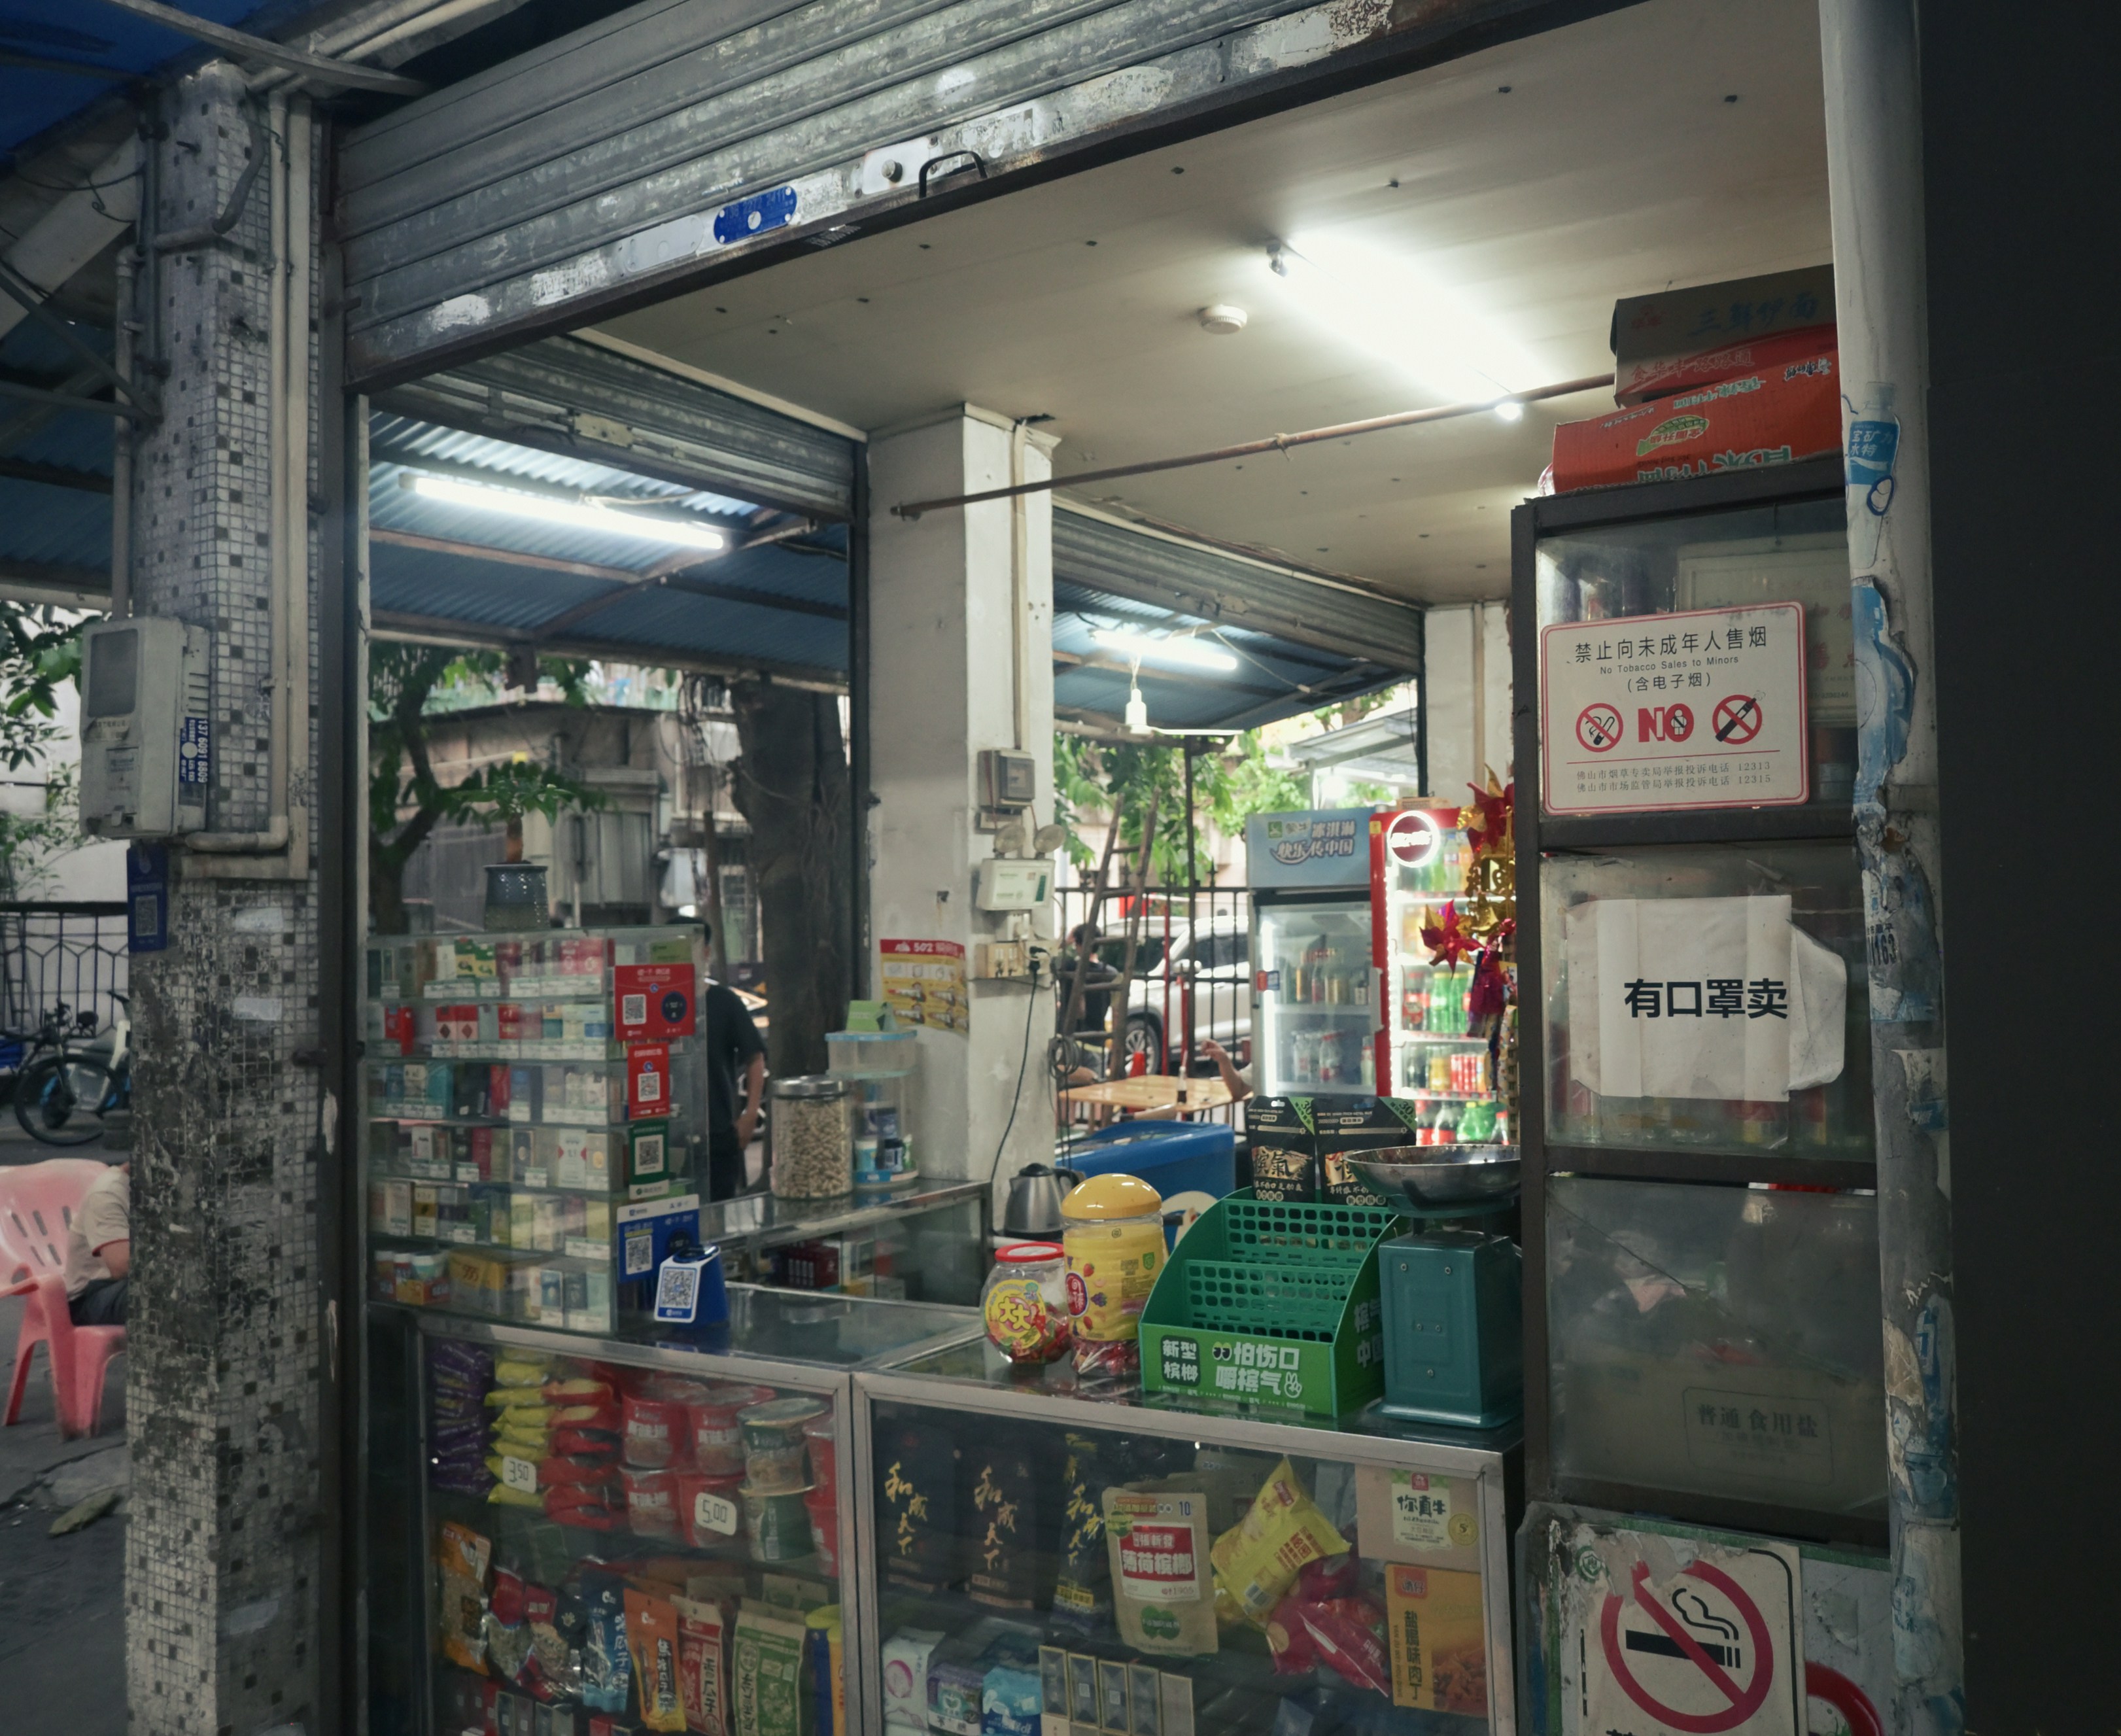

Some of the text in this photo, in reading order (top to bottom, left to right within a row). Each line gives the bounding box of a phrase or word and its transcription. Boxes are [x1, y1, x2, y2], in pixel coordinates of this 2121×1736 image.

[1575, 626, 1767, 663] 禁止向未成年人售烟
[1600, 655, 1739, 675] No Tobacco Sales to Minors
[198, 720, 208, 783] 137 6091 8809
[1576, 761, 1771, 782] 佛山市烟草专卖局举报投诉电话 12313
[1576, 774, 1772, 793] 佛山市市场监管局举报投诉电话 12315
[1311, 820, 1356, 839] 冰淇淋
[1623, 978, 1788, 1020] 有口罩卖
[1162, 1340, 1198, 1360] 新型
[1233, 1342, 1300, 1371] 怕伤口
[1164, 1361, 1198, 1382] 槟榔
[1215, 1365, 1283, 1396] 嚼槟气
[1699, 1404, 1819, 1438] 普通食用盐
[509, 1460, 530, 1483] 3.50
[702, 1499, 727, 1524] 5.00
[1180, 1501, 1192, 1516] 10
[1396, 1494, 1446, 1518] 你真牛
